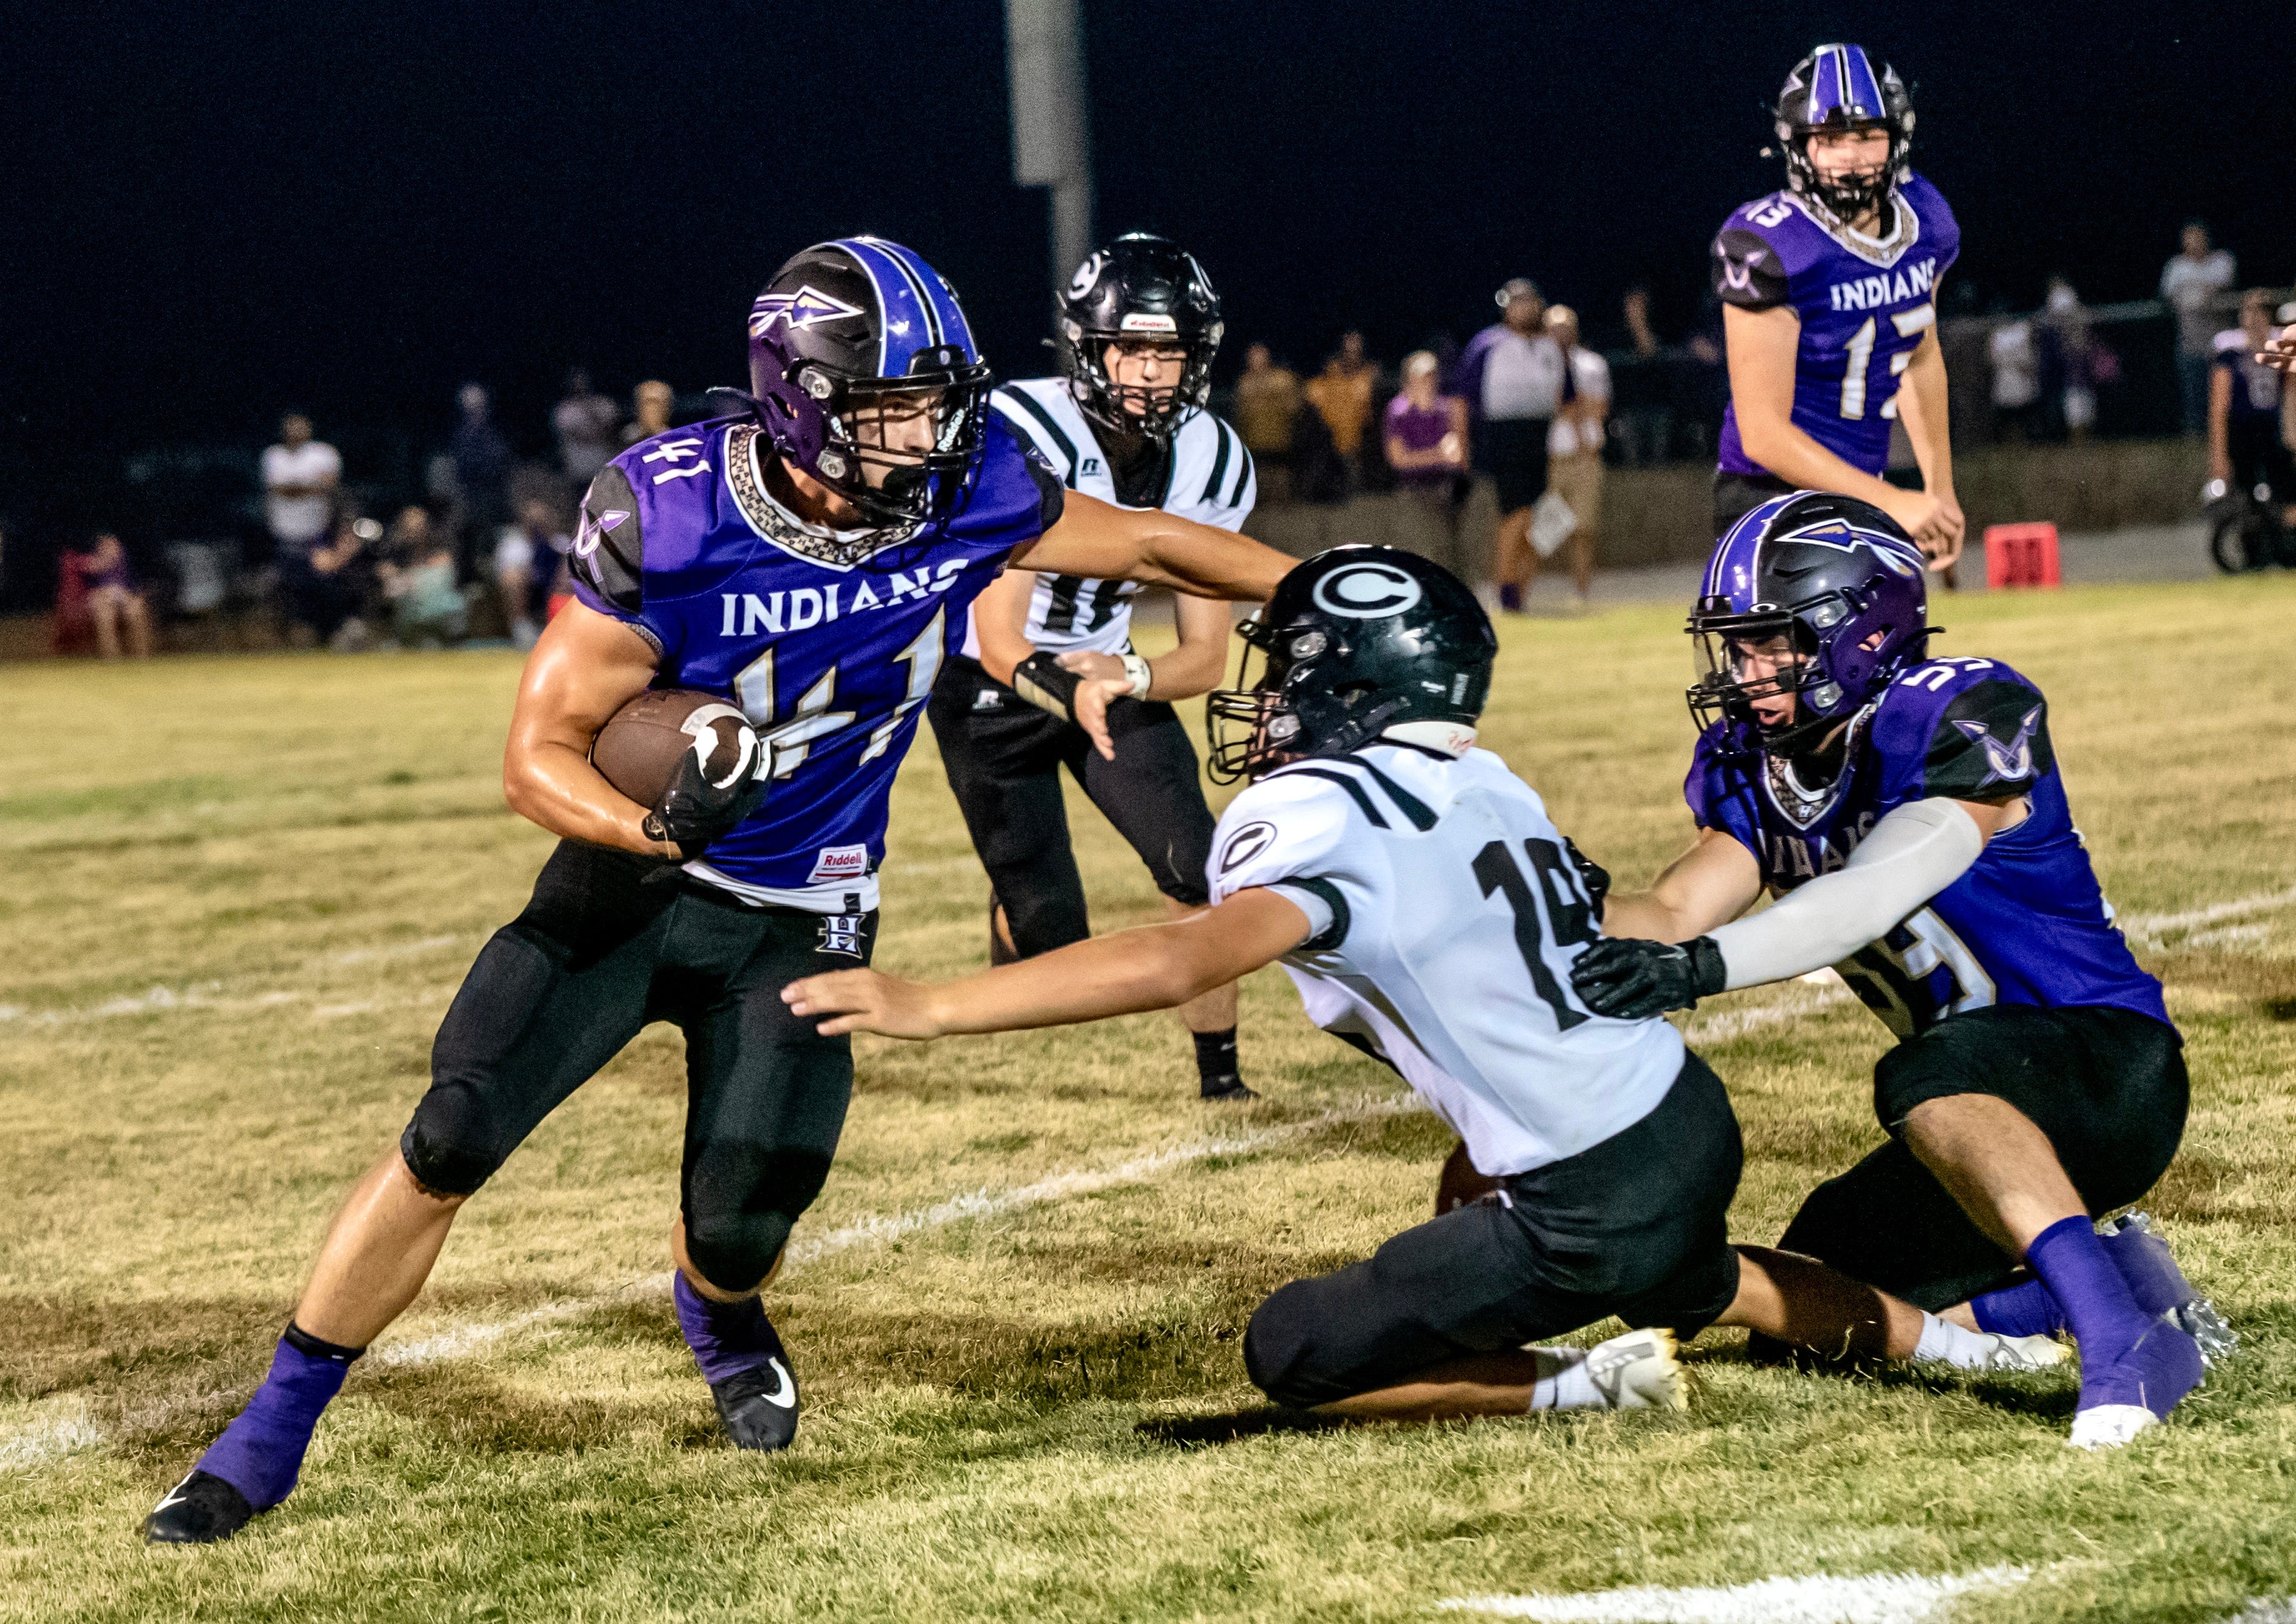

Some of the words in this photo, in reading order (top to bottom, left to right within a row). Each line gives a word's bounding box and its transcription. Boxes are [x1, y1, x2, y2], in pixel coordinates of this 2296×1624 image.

[1746, 200, 1793, 228] 13
[641, 438, 712, 485] 41
[720, 558, 969, 636] INDIANS
[1319, 566, 1414, 612] C
[733, 602, 945, 780] 41
[824, 852, 862, 866] Riddell
